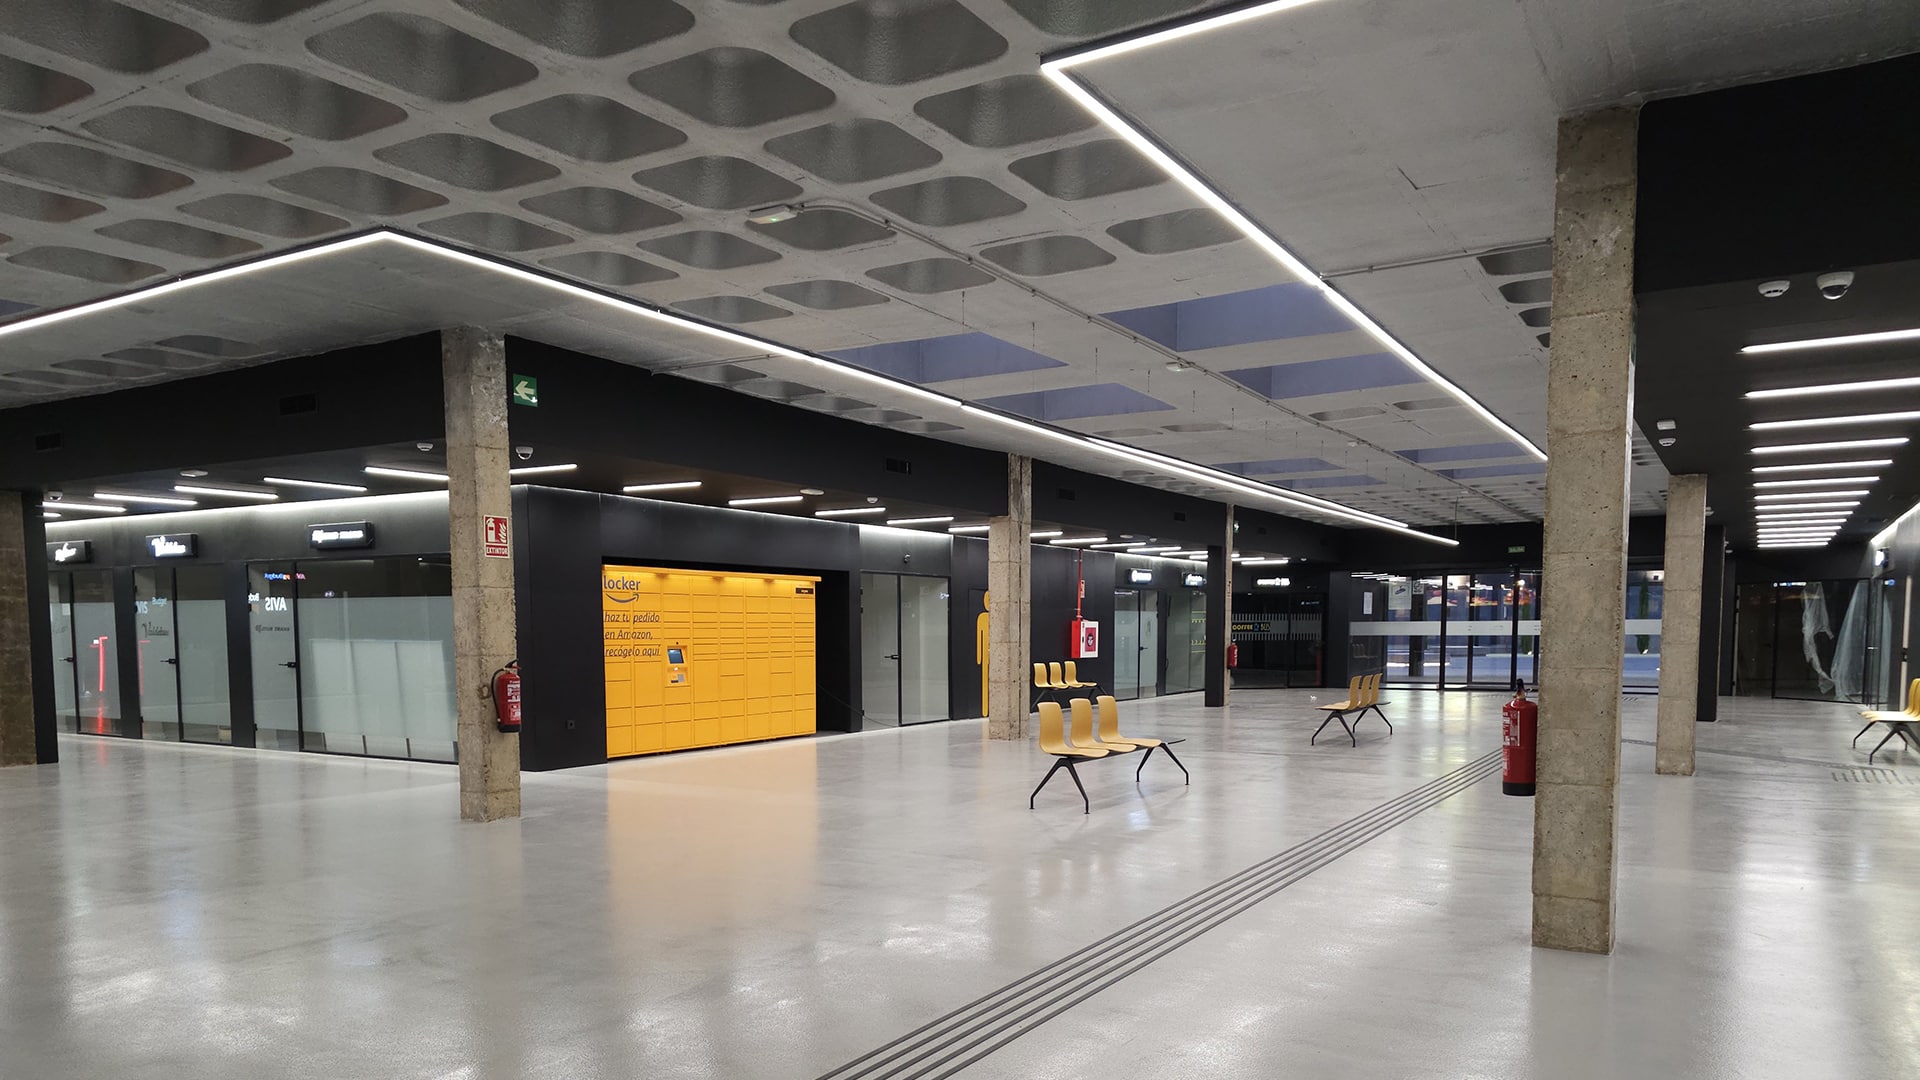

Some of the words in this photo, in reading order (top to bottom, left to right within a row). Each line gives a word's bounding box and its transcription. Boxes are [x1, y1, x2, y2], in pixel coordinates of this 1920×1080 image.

[604, 575, 640, 590] locker
[605, 612, 620, 622] haz
[623, 613, 629, 622] tu
[633, 613, 660, 624] pedido
[605, 631, 616, 640] en
[617, 630, 653, 640] Amazon,
[605, 644, 640, 658] recógelo
[642, 644, 661, 657] aquí
